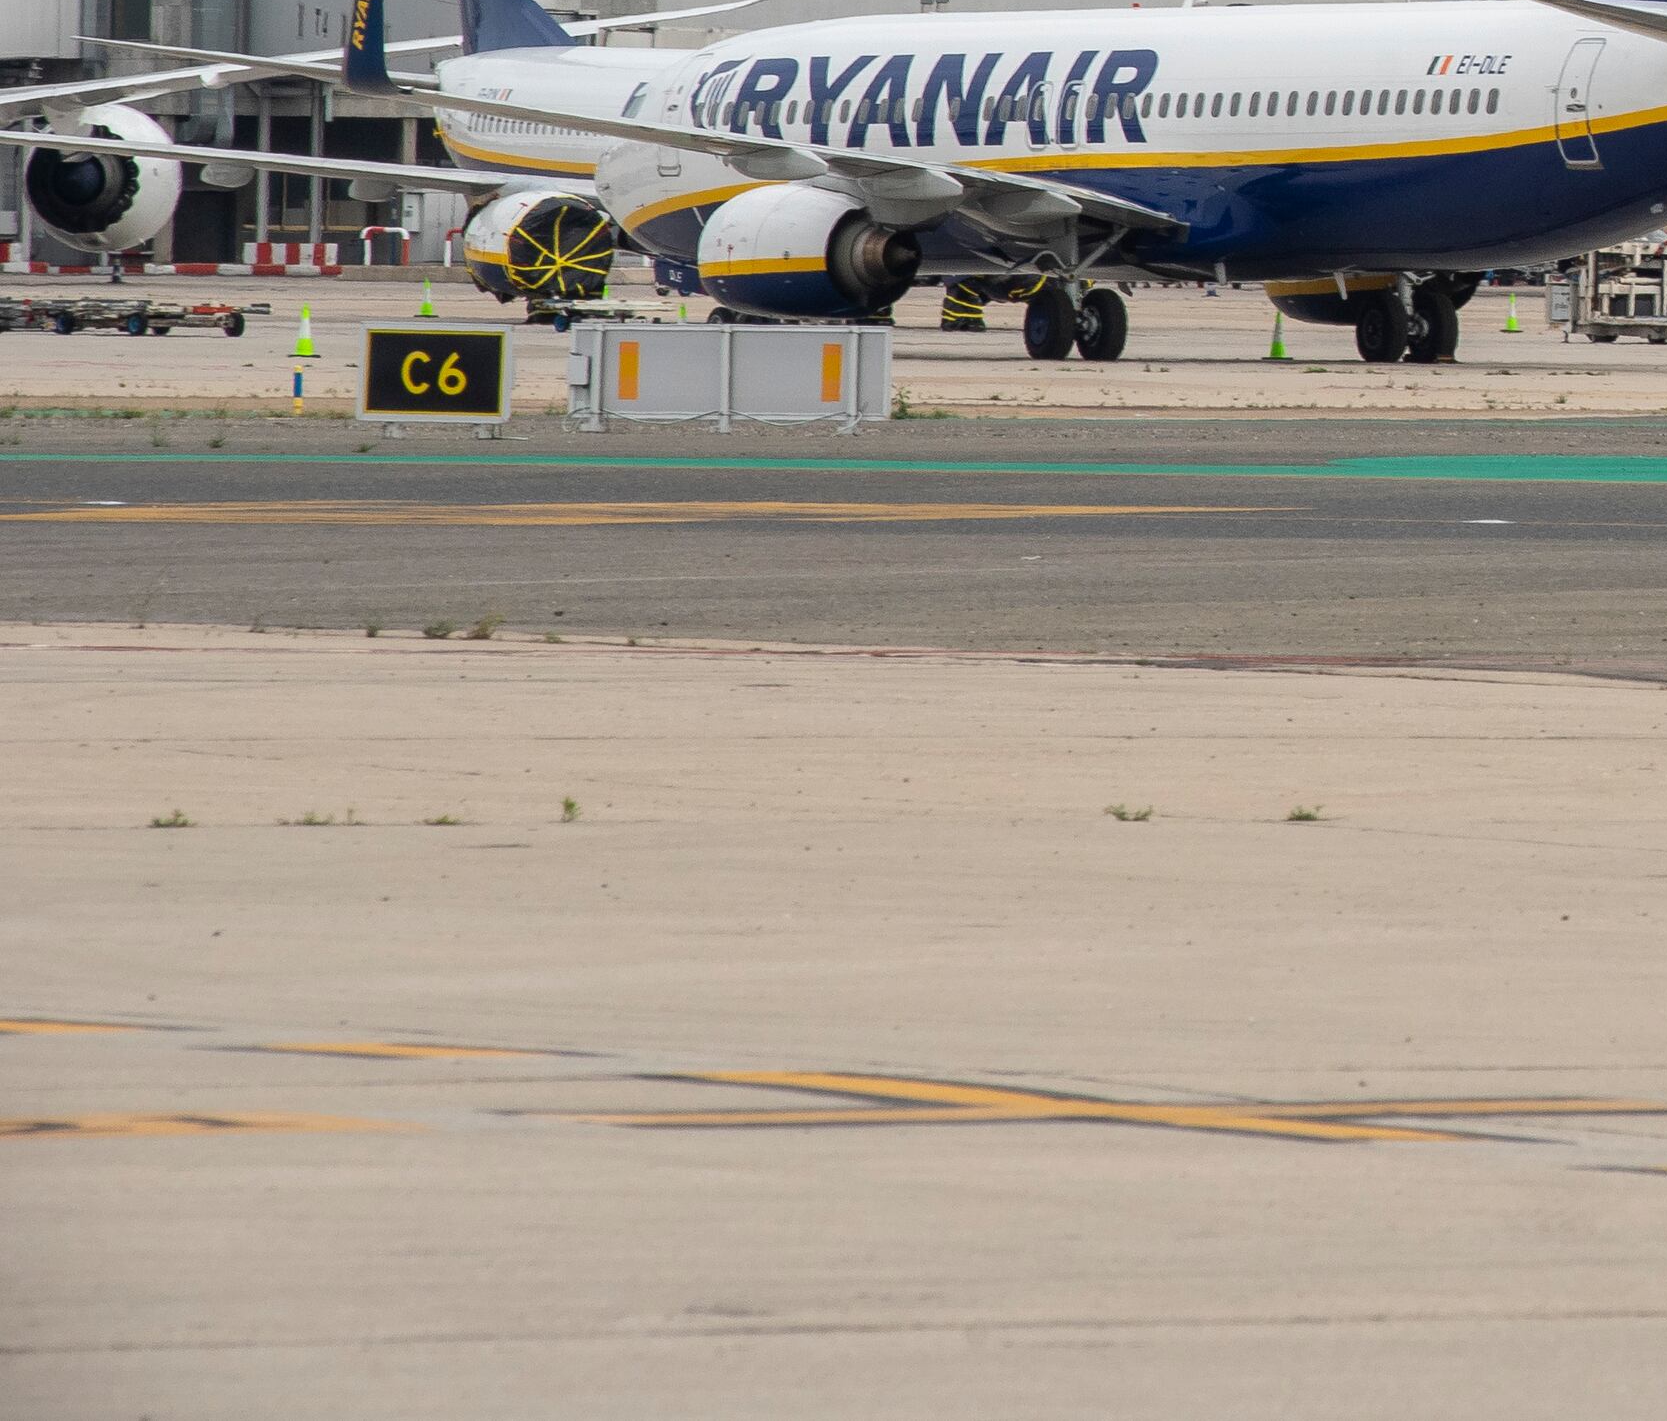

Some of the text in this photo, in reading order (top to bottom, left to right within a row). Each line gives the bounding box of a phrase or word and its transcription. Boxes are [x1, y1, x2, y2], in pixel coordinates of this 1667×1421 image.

[1456, 55, 1512, 74] EI-DLE
[729, 49, 1158, 148] RYANAIR
[401, 350, 467, 395] C6
